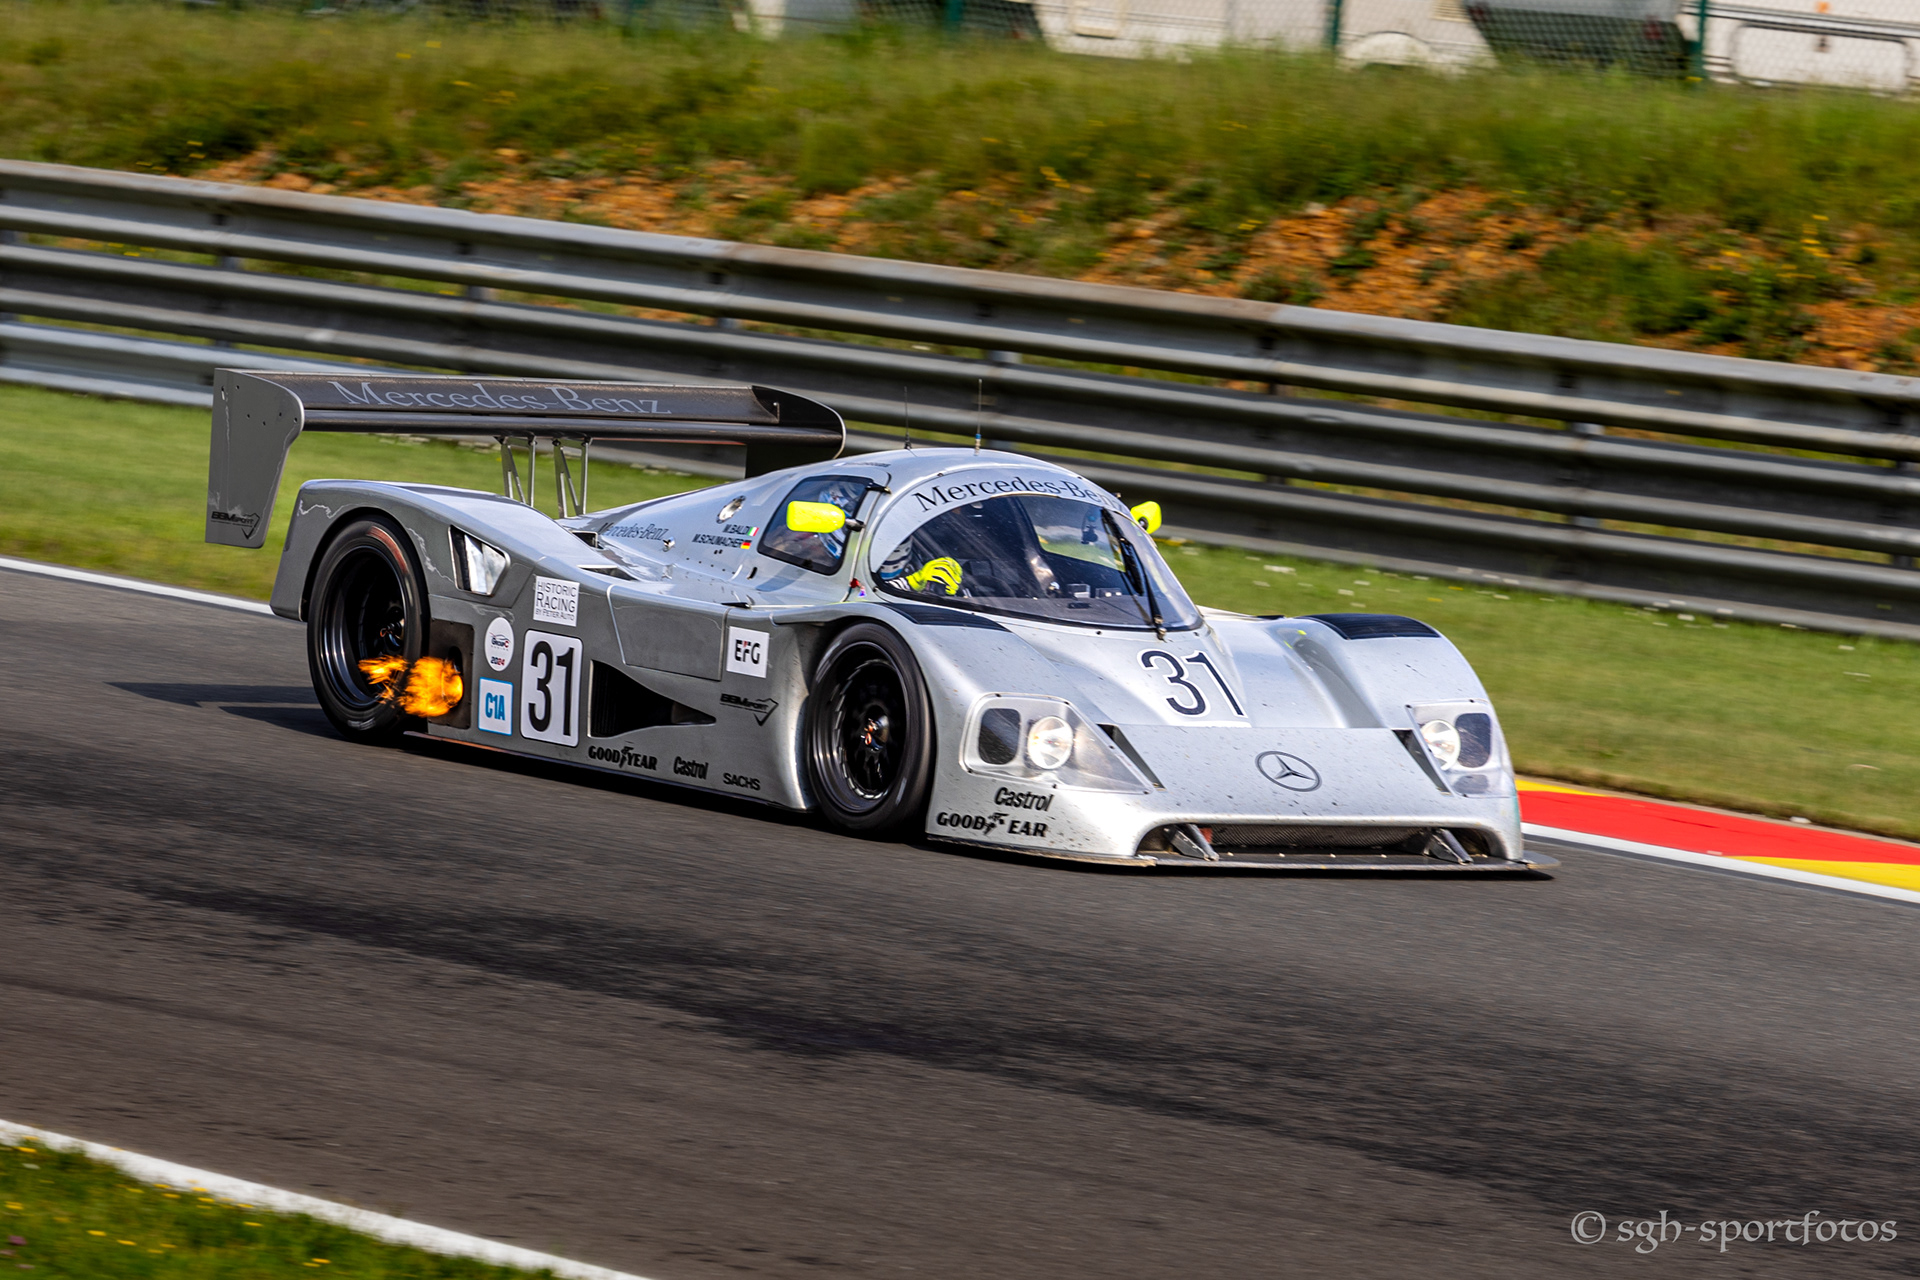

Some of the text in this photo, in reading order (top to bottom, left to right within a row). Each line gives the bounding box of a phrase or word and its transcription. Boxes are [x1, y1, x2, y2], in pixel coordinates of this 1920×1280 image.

[327, 380, 672, 415] Mercedes-Benz
[911, 476, 1124, 513] Mercedes-Benz
[599, 522, 669, 541] Mercedes-Benz
[536, 591, 576, 613] RACING
[537, 581, 577, 598] HISTORIC
[490, 656, 505, 666] 2024
[735, 639, 761, 665] EFG
[528, 640, 575, 736] 31
[1141, 650, 1245, 717] 31
[485, 692, 506, 721] C1A
[588, 745, 658, 771] GOODYEAR
[673, 756, 709, 780] Castrol
[723, 773, 761, 791] SACHS
[994, 786, 1055, 812] Castrol
[936, 811, 1049, 838] GOODEAR
